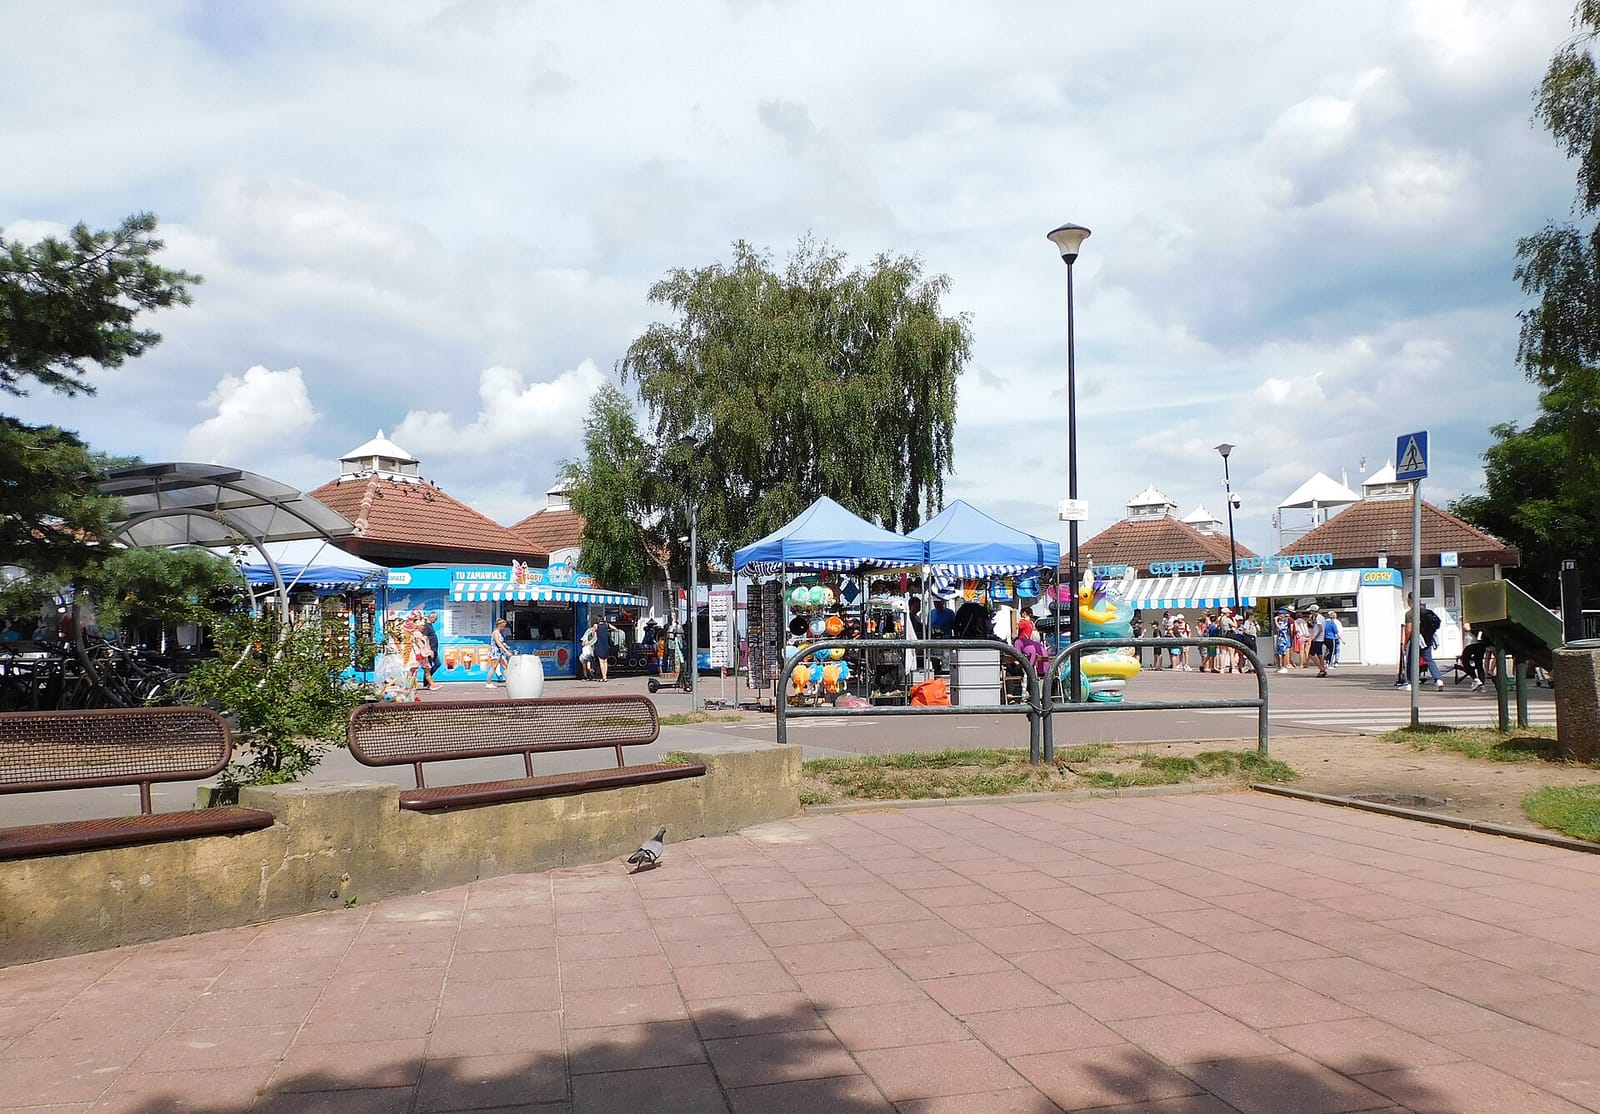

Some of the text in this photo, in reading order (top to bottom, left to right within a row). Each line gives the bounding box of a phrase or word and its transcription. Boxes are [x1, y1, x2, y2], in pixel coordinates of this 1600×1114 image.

[1444, 554, 1456, 562] WC
[1149, 560, 1205, 575] GOFRY
[456, 571, 507, 580] TU ZAMAWIASZ
[1364, 571, 1392, 583] GOFRY
